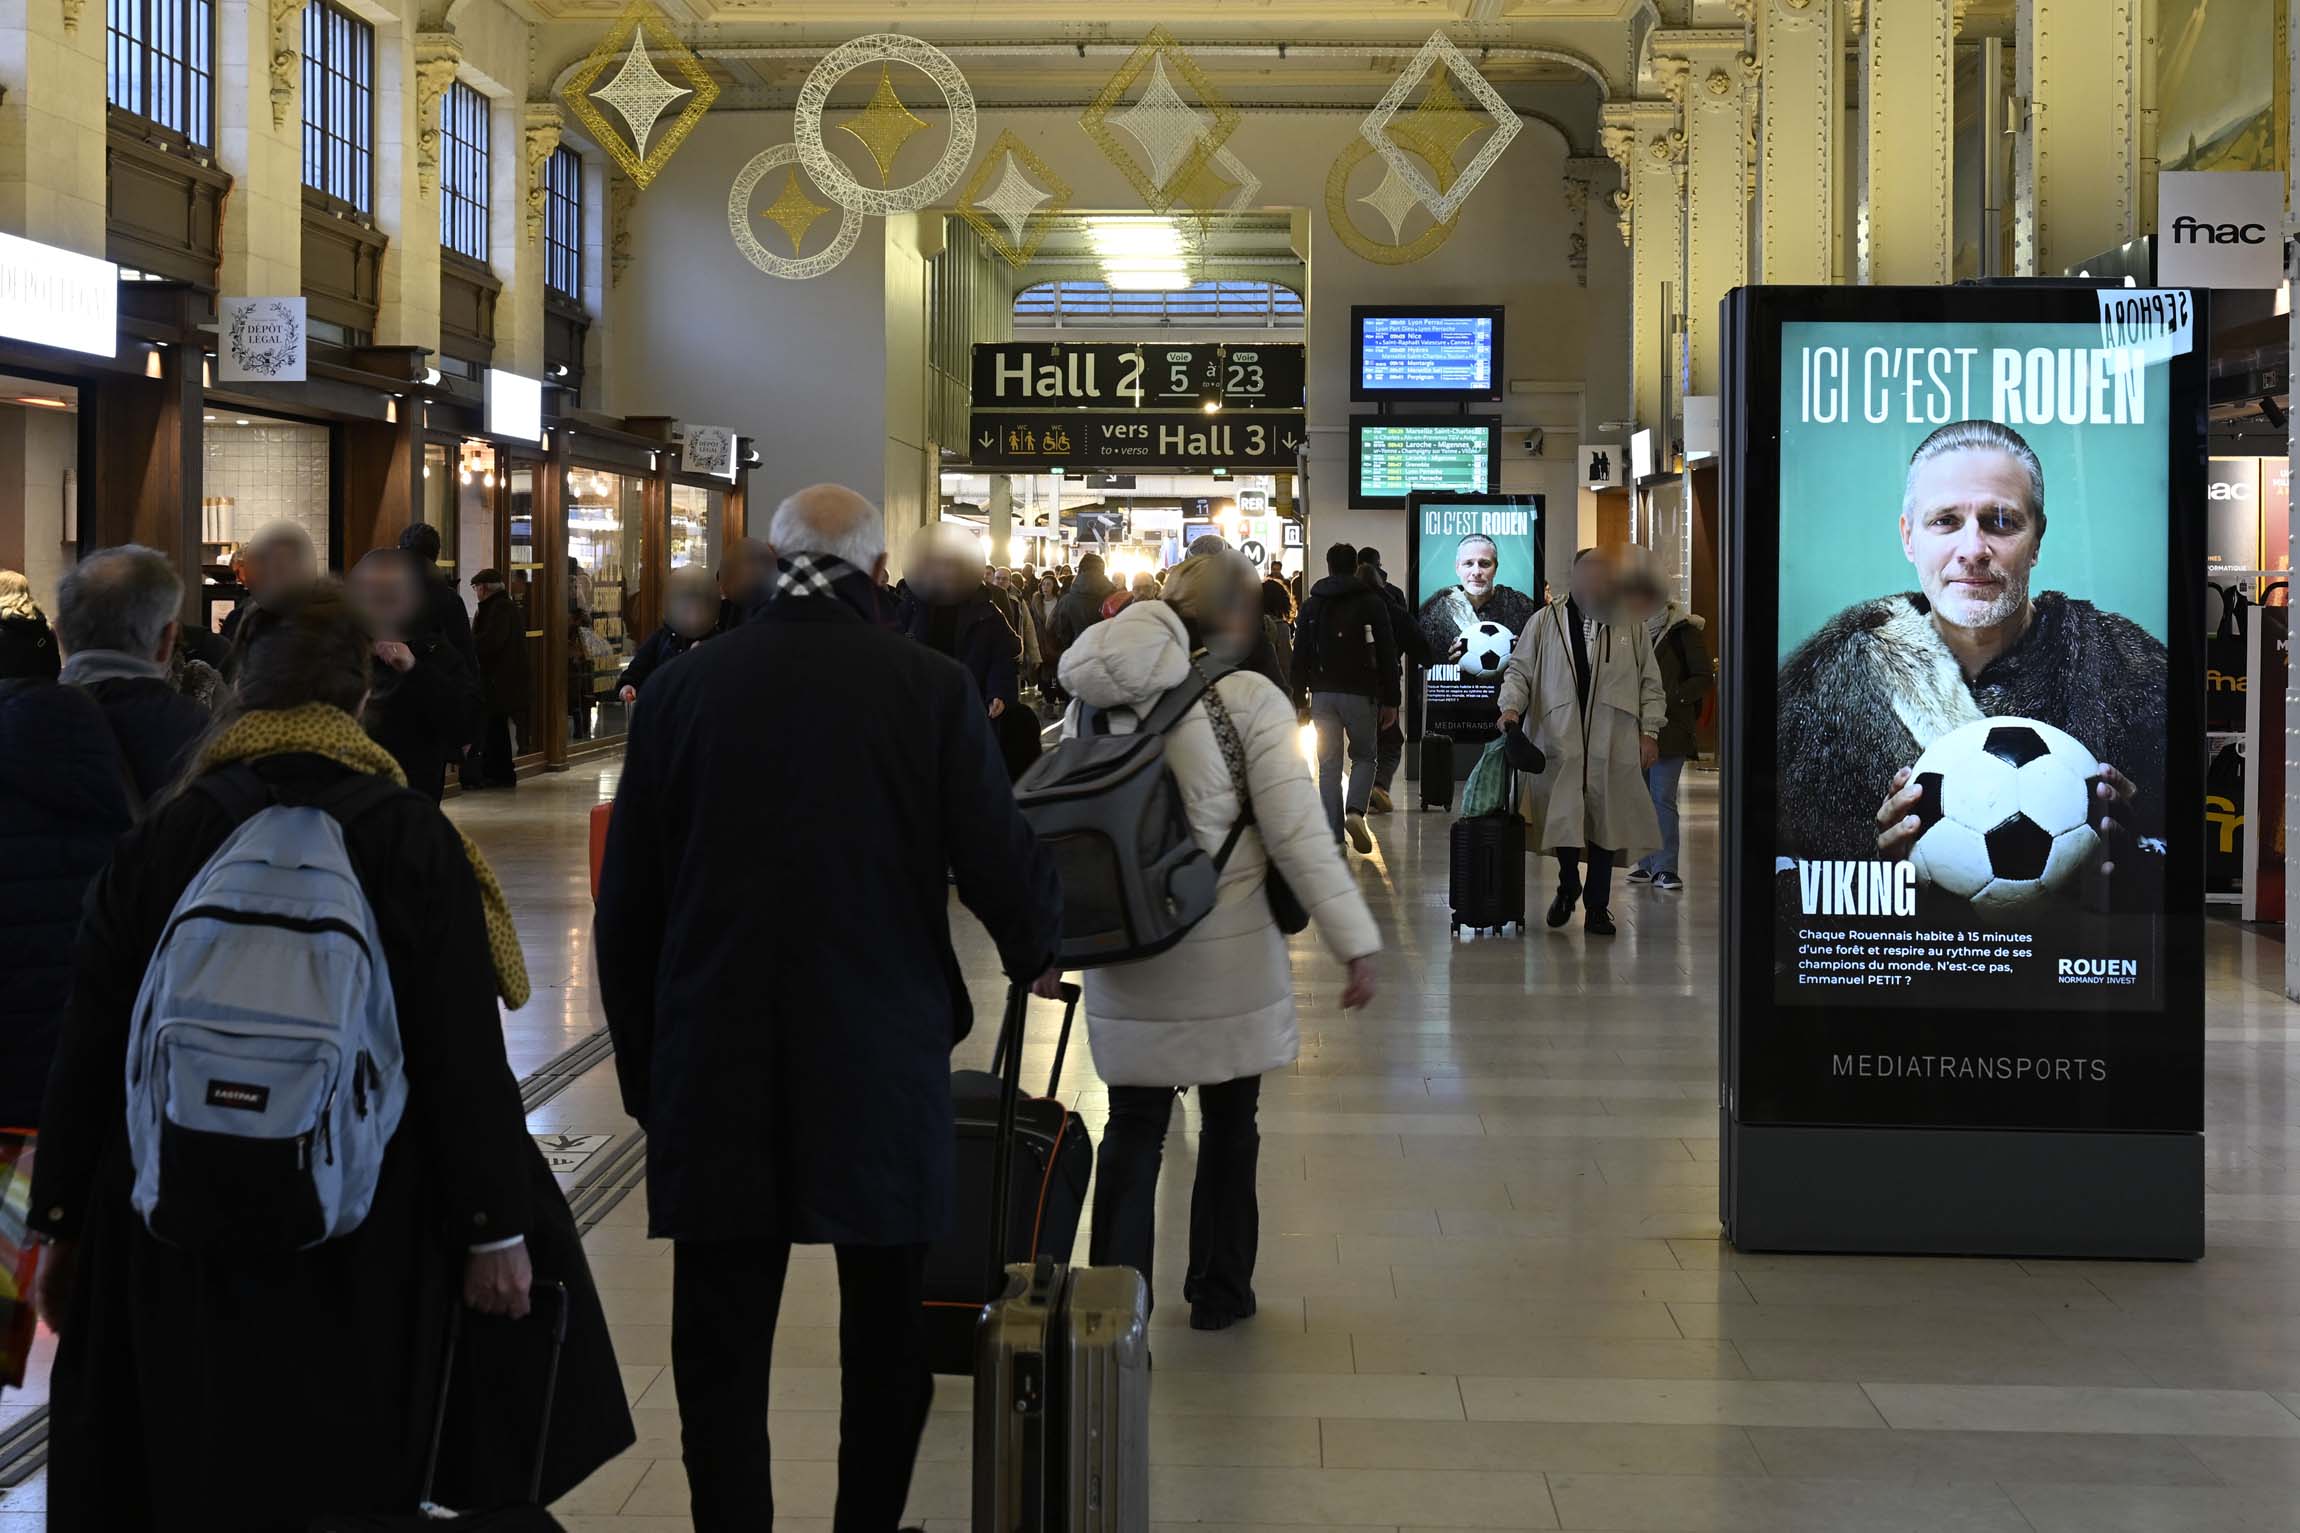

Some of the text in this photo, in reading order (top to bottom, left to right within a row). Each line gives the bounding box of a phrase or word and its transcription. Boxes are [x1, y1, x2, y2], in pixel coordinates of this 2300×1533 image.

[2172, 216, 2266, 244] fnac
[995, 353, 1264, 397] Hall 2 5 à 23
[1802, 347, 2145, 425] ICI C'EST ROUEN
[1101, 424, 1149, 438] vers
[1159, 425, 1266, 455] Hall 3
[1100, 446, 1149, 455] to verso
[1437, 441, 1470, 449] Migennes
[2208, 482, 2254, 501] ac
[1196, 503, 1209, 514] 11
[1241, 497, 1265, 511] RER
[1425, 511, 1528, 536] ICI C'EST ROUEN
[1244, 545, 1261, 563] M
[2207, 669, 2247, 692] fna
[1798, 859, 1916, 917] VIKING
[1798, 929, 2033, 943] Chaque Rouennais habite à 15 minutes
[1798, 945, 2033, 959] d'une forêt et respire au rythme de ses
[1798, 959, 2013, 974] champions du monde. N'est-ce pas,
[2058, 958, 2137, 976] ROUEN
[1798, 974, 1912, 986] Emmanuel PETIT ?
[2058, 976, 2136, 985] NORMANDY INVEST
[1832, 1054, 2107, 1082] MEDIATRANSPORTS
